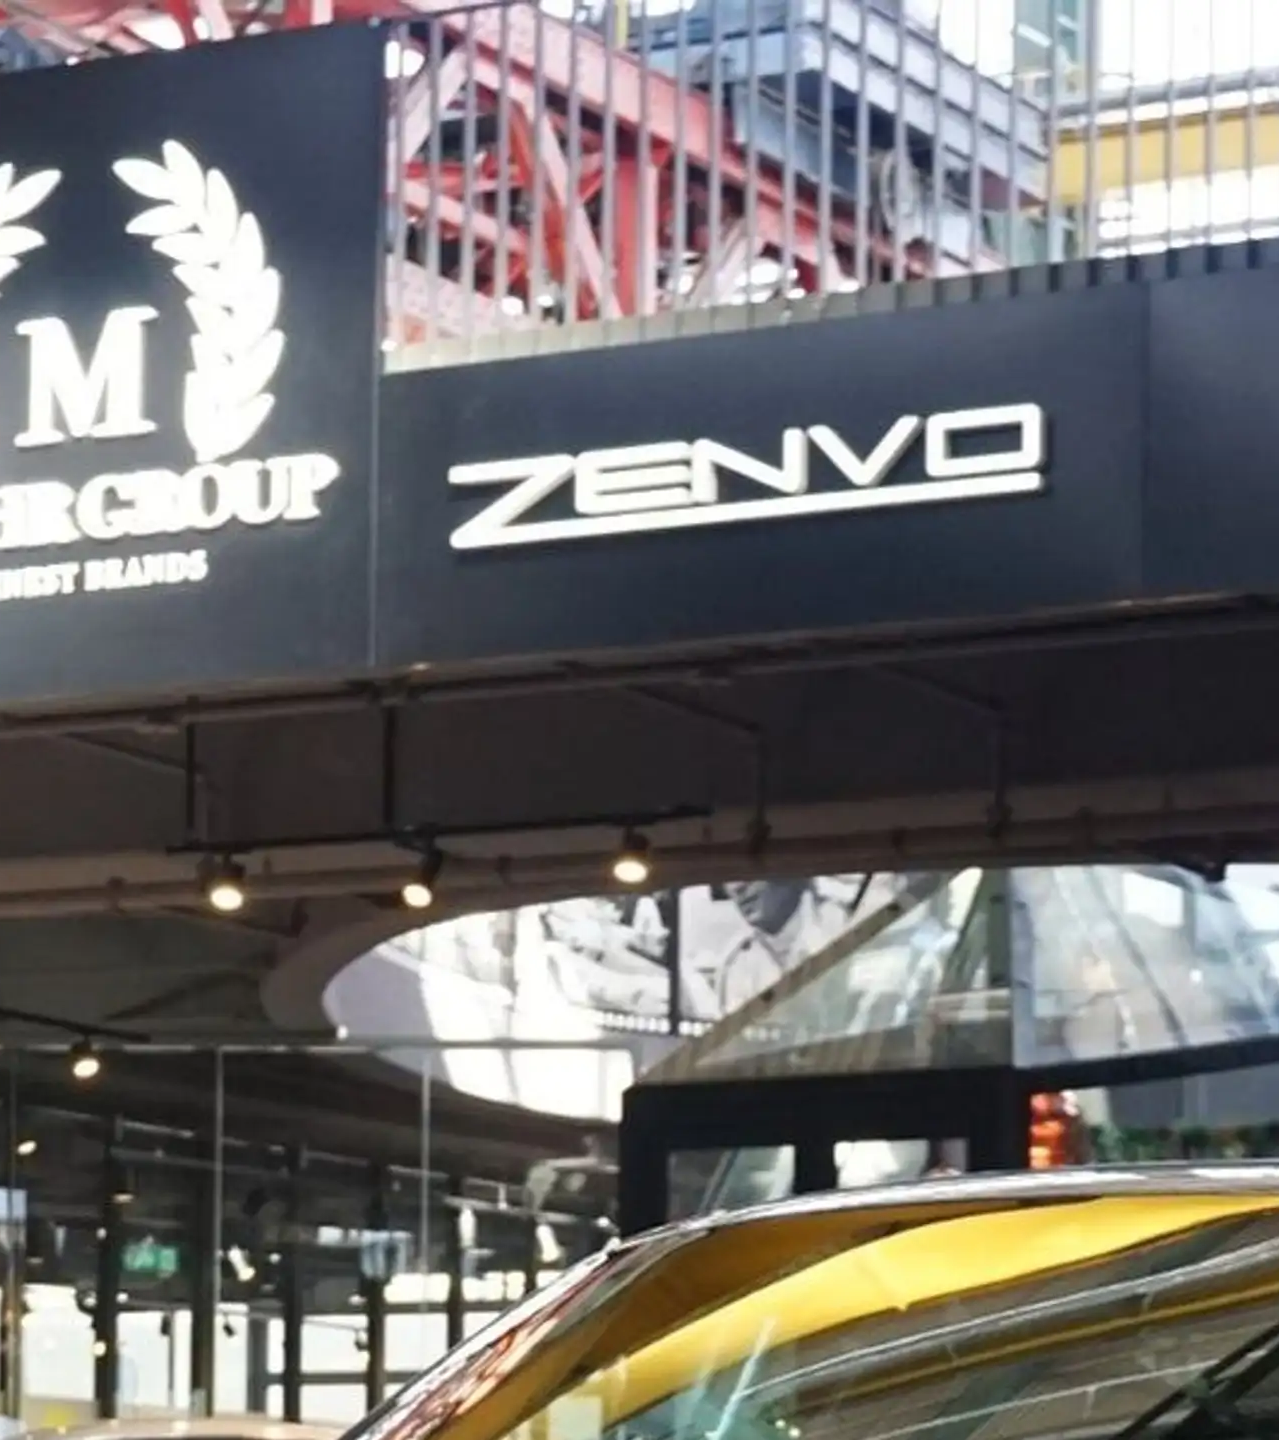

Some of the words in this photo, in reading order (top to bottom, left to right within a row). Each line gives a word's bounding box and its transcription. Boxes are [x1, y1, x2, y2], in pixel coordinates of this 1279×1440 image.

[14, 306, 160, 447] M
[76, 453, 341, 540] GROUP
[447, 403, 1043, 549] ZENVO
[84, 549, 209, 592] BRANDS
